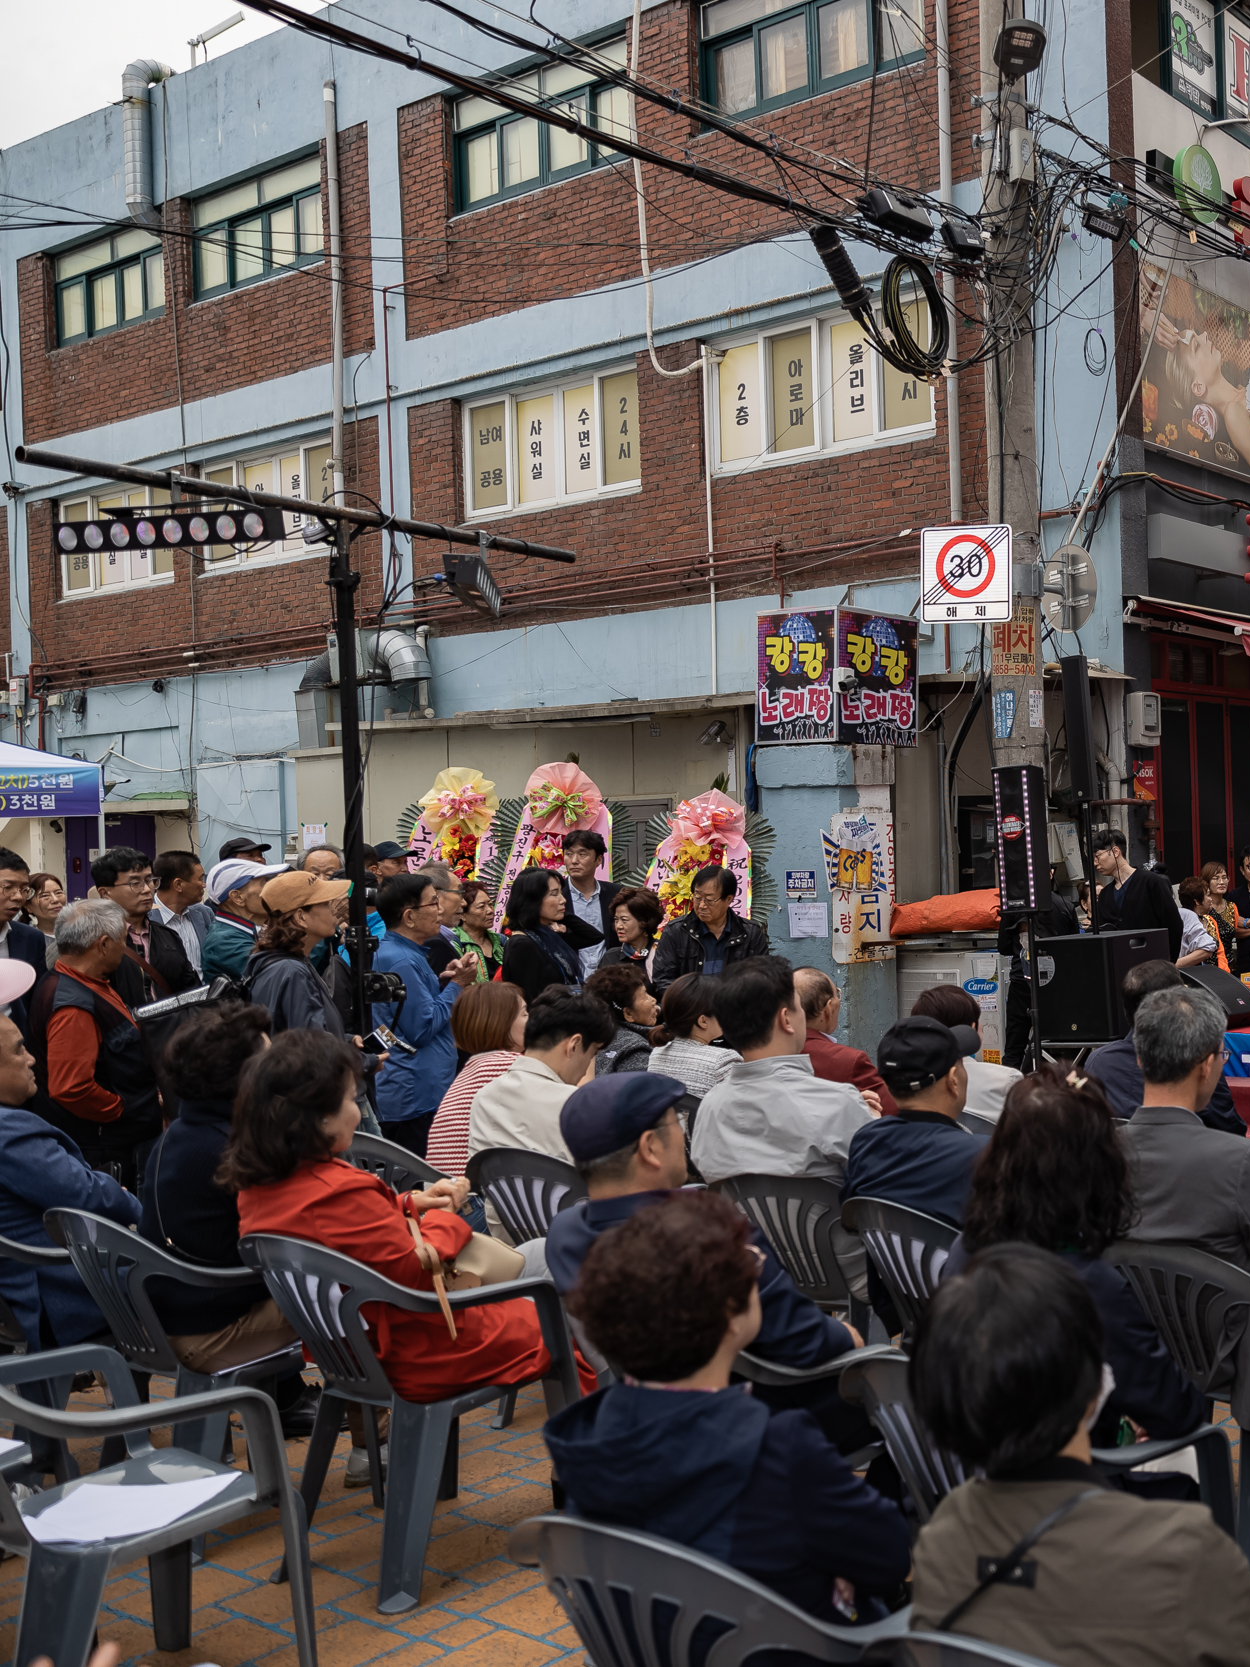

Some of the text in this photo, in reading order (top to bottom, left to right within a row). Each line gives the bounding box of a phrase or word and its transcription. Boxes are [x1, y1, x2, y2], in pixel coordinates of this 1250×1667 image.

[787, 358, 805, 427] 아로마
[848, 344, 866, 415] 올리브
[734, 382, 750, 427] 2층
[478, 424, 503, 446] 남여
[577, 408, 593, 471] 수면실
[618, 396, 632, 461] 24시
[529, 418, 543, 481] 샤워실
[479, 467, 504, 489] 공용
[73, 555, 89, 571] 공용
[949, 553, 983, 580] 30
[993, 623, 1035, 653] 폐차
[1004, 653, 1035, 664] 무료폐차
[758, 685, 832, 727] 노래짱
[840, 688, 916, 730] 노래짱
[9, 794, 56, 811] 3천원
[511, 824, 537, 864] 광진구
[728, 857, 748, 870] 祝
[788, 878, 814, 888] 주차금지
[968, 982, 994, 991] Carrier
